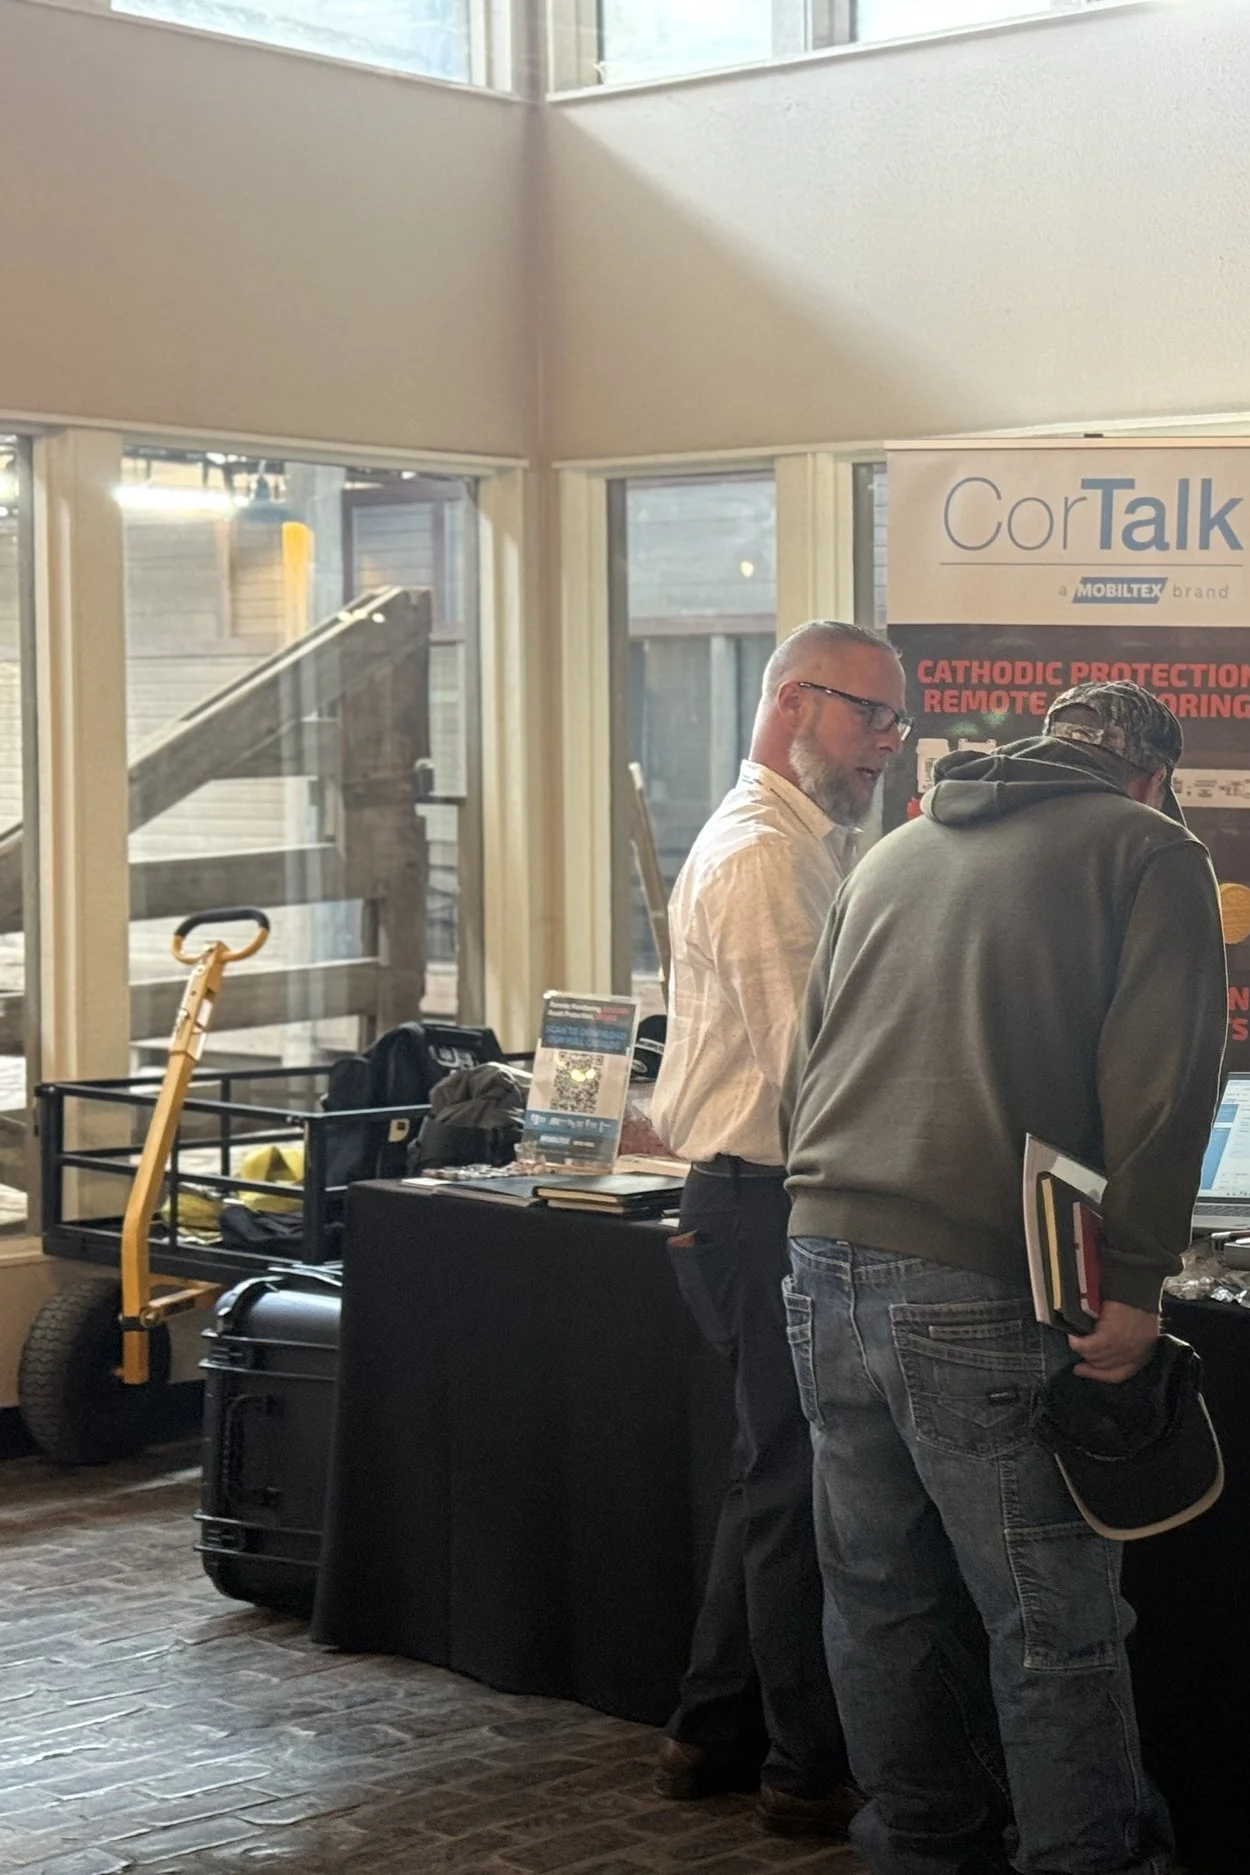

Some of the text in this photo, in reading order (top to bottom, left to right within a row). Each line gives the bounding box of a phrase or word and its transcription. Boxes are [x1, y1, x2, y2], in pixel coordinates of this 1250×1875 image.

[943, 476, 1244, 551] CorTalk
[1058, 582, 1230, 600] a MOBILTEX brand
[917, 659, 1063, 685] CATHODIC
[923, 688, 1047, 716] REMOTE
[1228, 986, 1250, 1011] N
[1230, 1018, 1249, 1041] S
